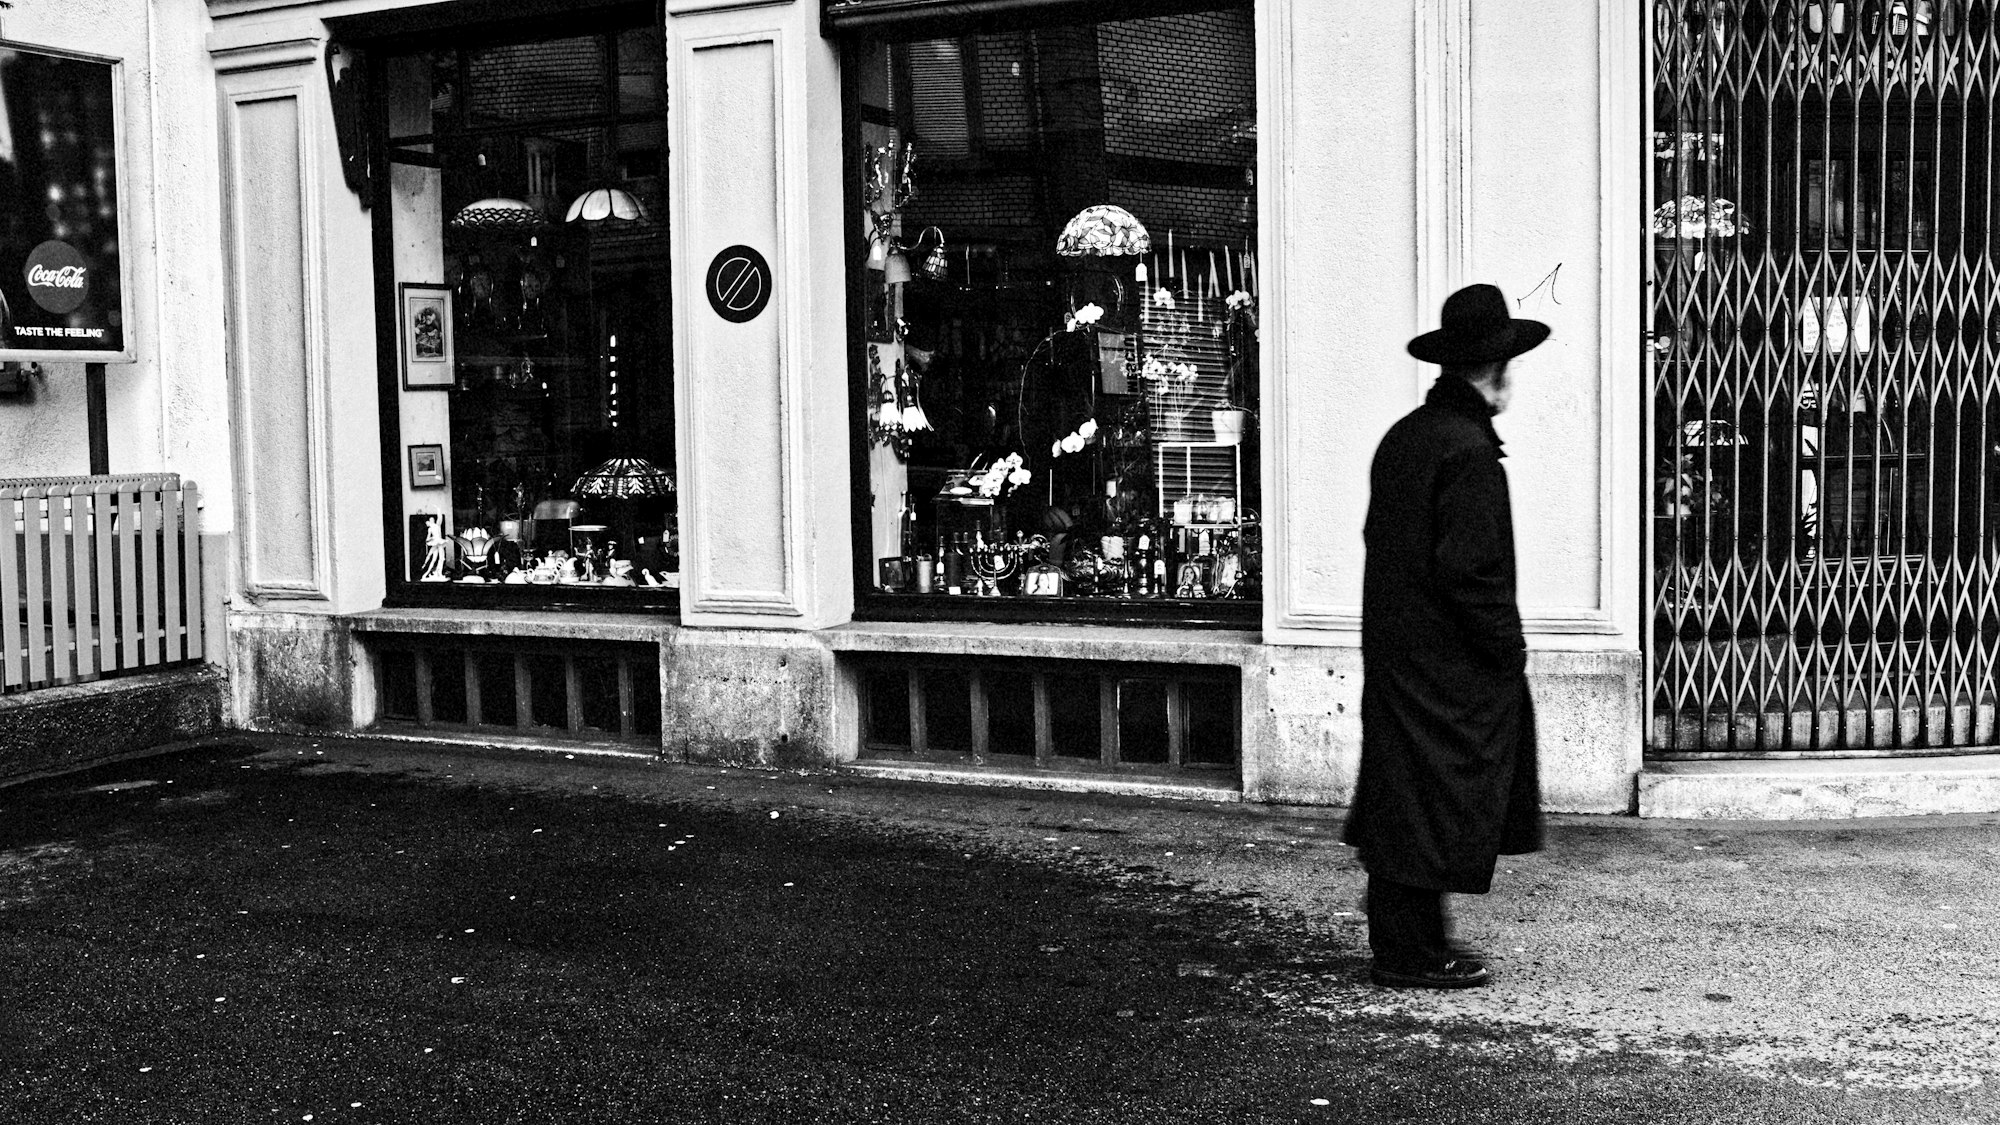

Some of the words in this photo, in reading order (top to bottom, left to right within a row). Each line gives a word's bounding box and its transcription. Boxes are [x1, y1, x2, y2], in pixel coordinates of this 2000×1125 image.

[28, 264, 87, 288] Coca-Cola
[14, 326, 44, 337] TASTE
[44, 327, 64, 337] THE
